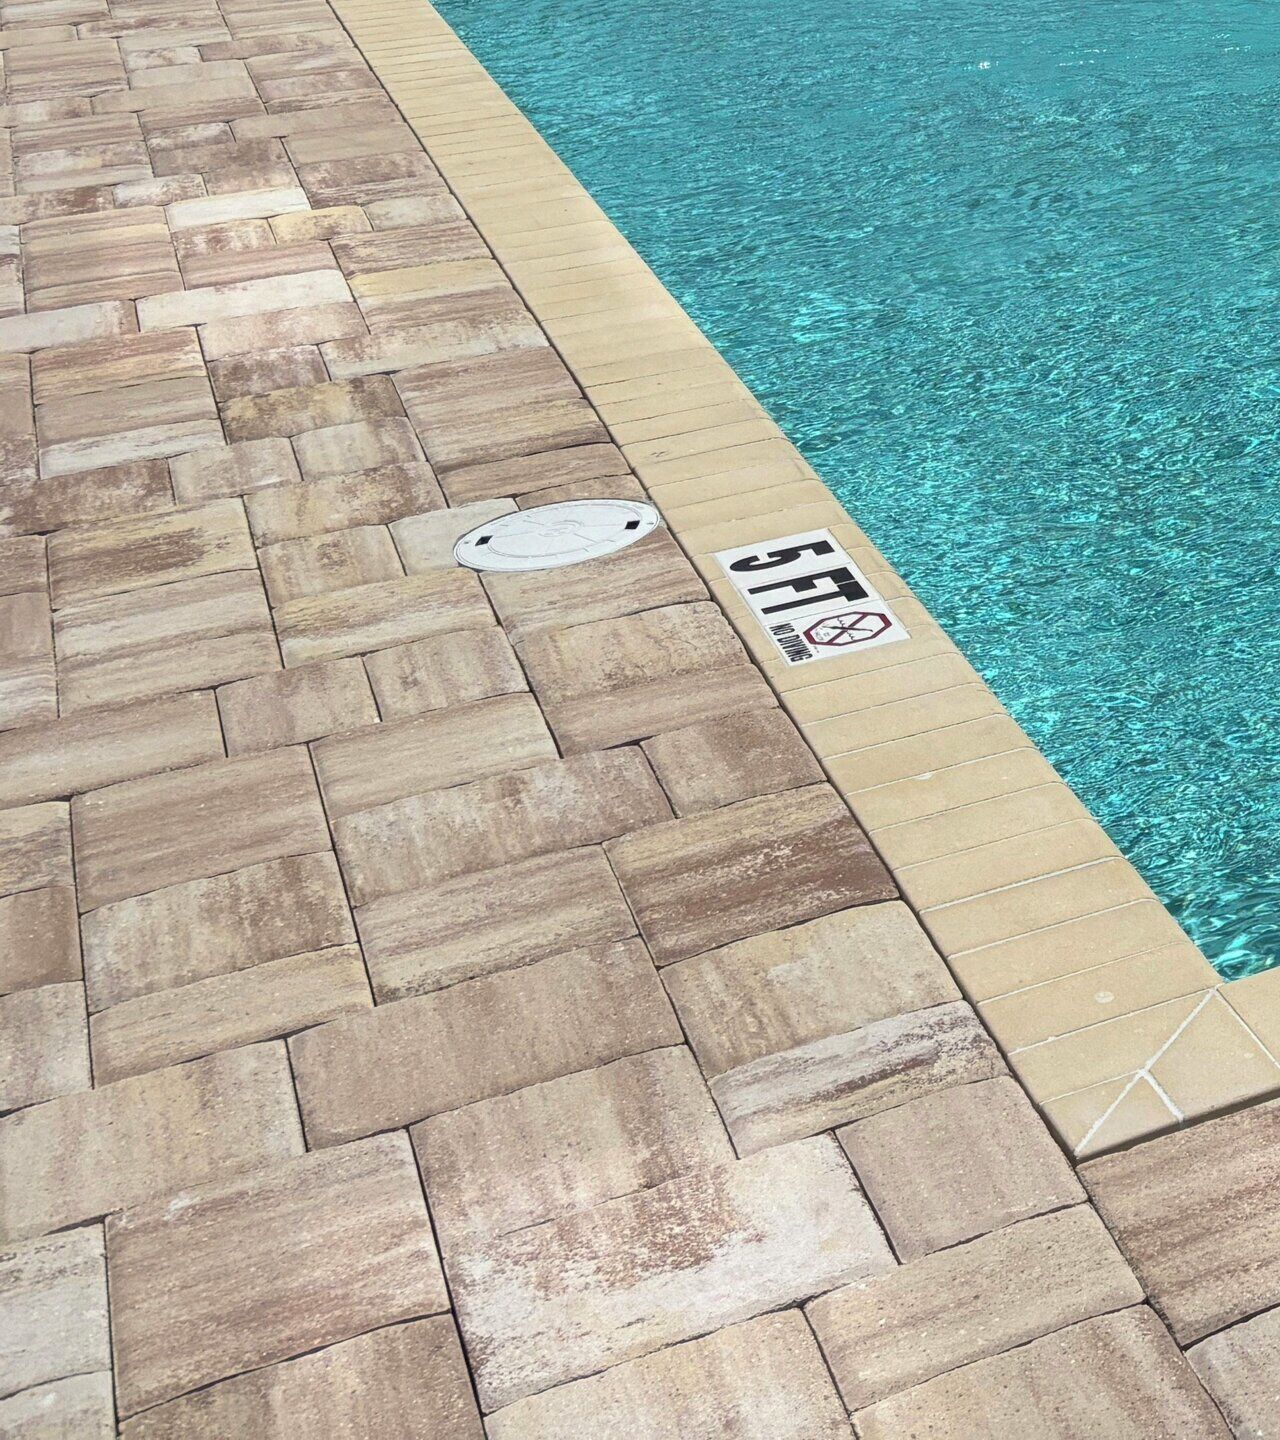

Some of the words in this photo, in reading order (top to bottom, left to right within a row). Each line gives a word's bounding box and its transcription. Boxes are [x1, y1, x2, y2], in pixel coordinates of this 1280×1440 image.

[730, 540, 835, 573] 5
[747, 567, 869, 614] FT
[770, 623, 795, 636] NO
[777, 634, 814, 662] DIVING
